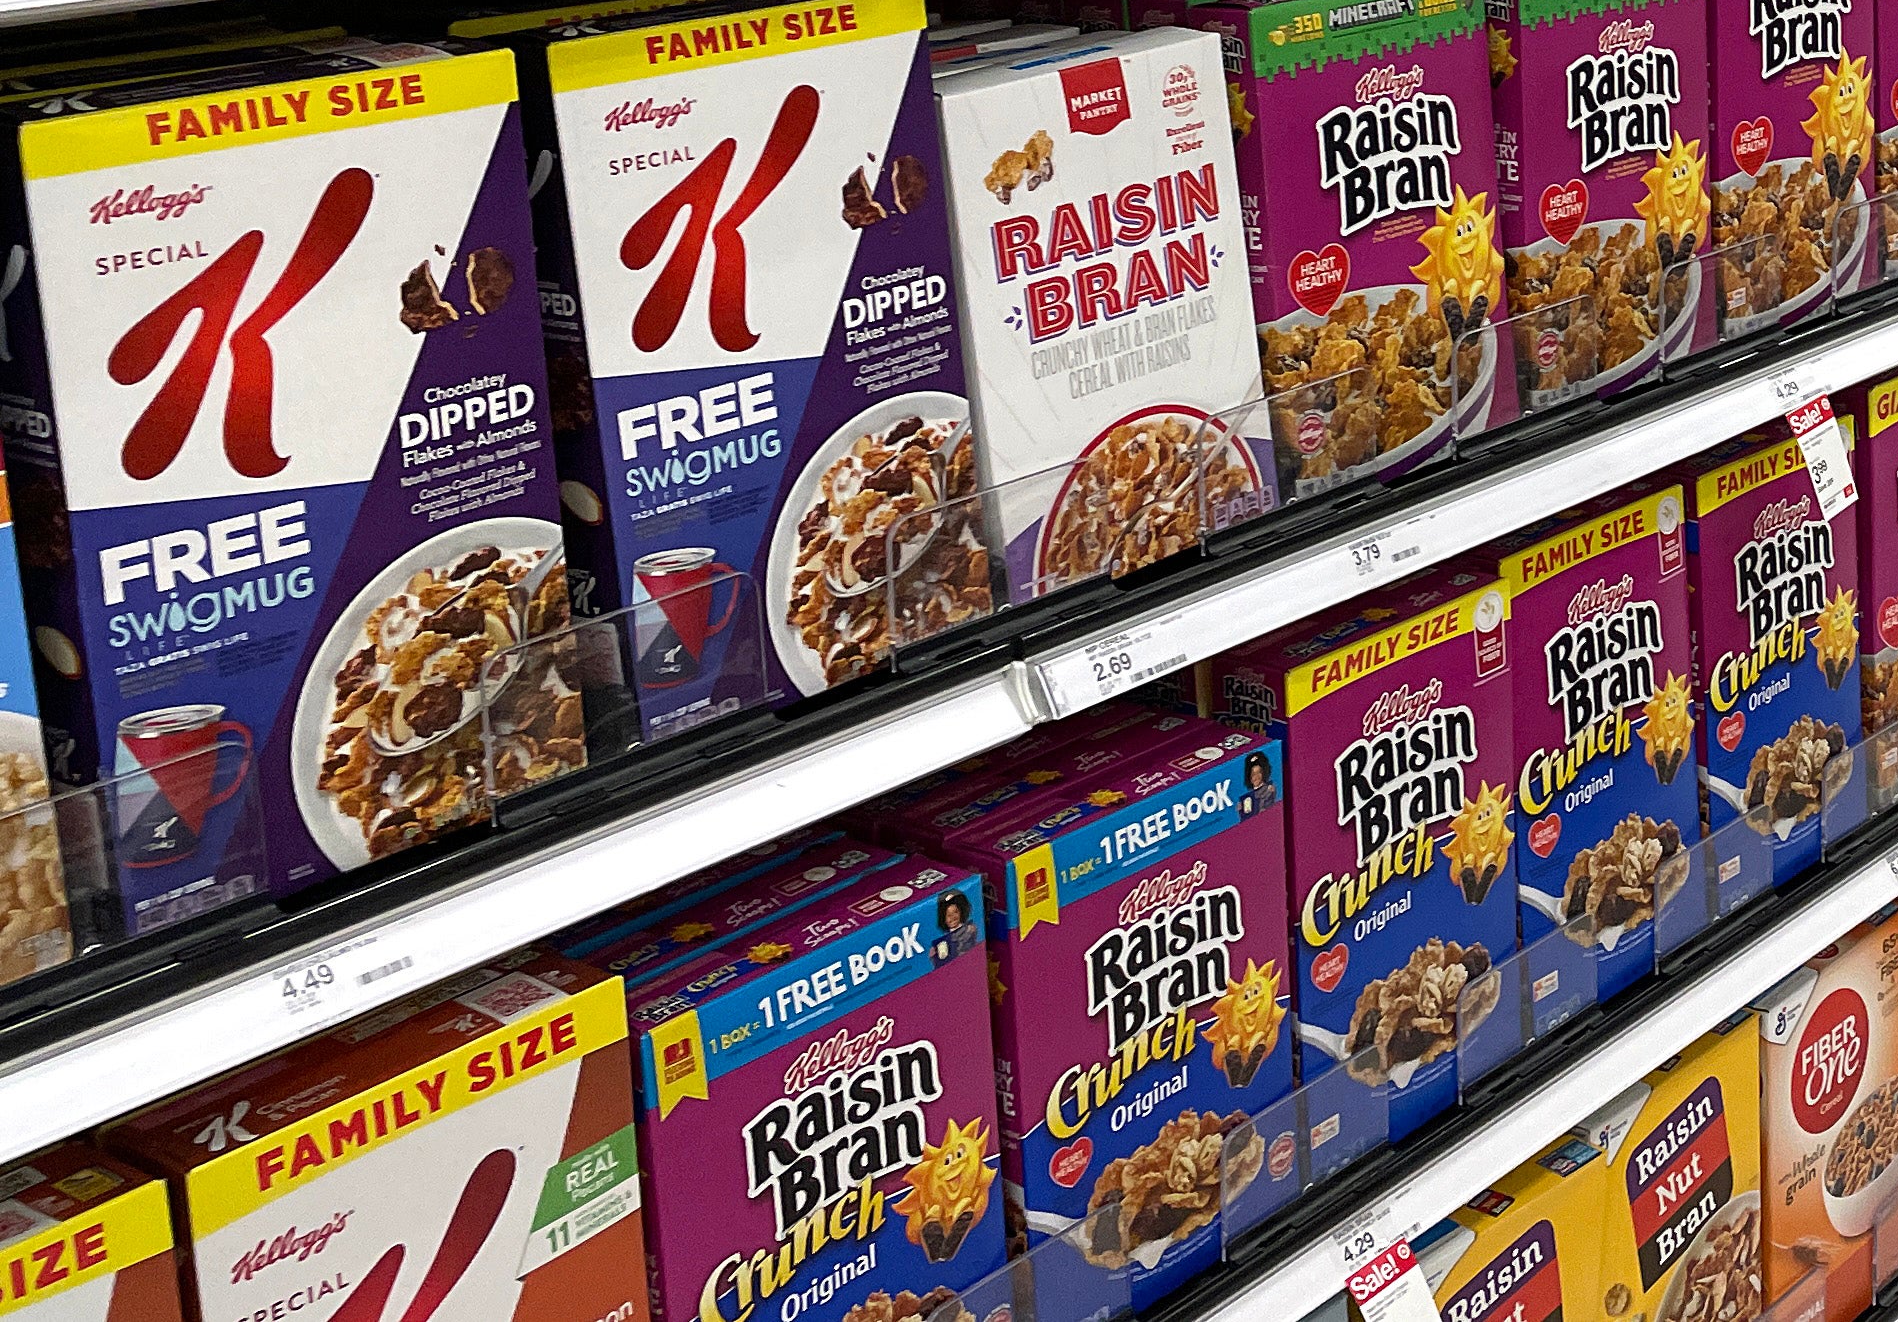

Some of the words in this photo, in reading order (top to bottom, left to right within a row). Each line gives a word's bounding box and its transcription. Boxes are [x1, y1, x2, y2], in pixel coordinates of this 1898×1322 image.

[645, 19, 768, 64] FAMILY
[784, 4, 857, 40] SIZE
[1761, 7, 1843, 79] Bran
[146, 92, 308, 146] FAMILY
[328, 75, 425, 117] SIZE
[1071, 87, 1122, 114] MARKET
[1355, 65, 1424, 104] Kellogg's
[1172, 139, 1204, 156] Fiber
[1318, 95, 1460, 189] Raisin
[89, 184, 206, 224] Kellogg's
[993, 163, 1220, 283] RAISIN
[1341, 147, 1454, 237] Bran
[96, 241, 209, 275] SPECIAL
[1023, 234, 1211, 344] BRAN
[1296, 265, 1344, 292] HEALTHY
[1300, 256, 1336, 277] HEART
[842, 275, 947, 328] DIPPED
[1098, 327, 1134, 360] WHEAT
[1147, 313, 1176, 342] BRAN
[1179, 296, 1216, 333] FLAKES
[424, 373, 507, 404] Chocolatey
[1069, 366, 1112, 400] CEREAL
[1115, 356, 1146, 383] WITH
[1148, 334, 1191, 373] RAISINS
[1776, 380, 1799, 400] 4.29
[399, 385, 535, 447] DIPPED
[403, 443, 454, 469] Flakes
[476, 419, 537, 448] Almonds
[1790, 402, 1823, 434] Sale!
[100, 501, 311, 607] FREE
[1352, 545, 1381, 568] 3.79
[1093, 653, 1132, 681] 2.69
[1310, 631, 1401, 693] FAMILY
[1405, 606, 1461, 651] SIZE
[1336, 707, 1476, 825] Raisin
[1359, 761, 1465, 867] Bran
[1301, 820, 1435, 947] Crunch
[1354, 891, 1412, 941] Original
[281, 964, 335, 1000] 4.49
[759, 995, 775, 1027] 1
[776, 971, 848, 1023] FREE
[849, 923, 925, 987] BOOK
[784, 1016, 893, 1093] Kellogg's
[1801, 1015, 1856, 1076] FIBER
[256, 1073, 448, 1193] FAMILY
[468, 1013, 578, 1094] SIZE
[744, 1040, 941, 1199] Raisin
[1634, 1093, 1717, 1185] Raisin
[565, 1151, 619, 1193] REAL
[770, 1104, 926, 1240] Bran
[1655, 1154, 1704, 1214] Nut
[699, 1176, 887, 1322] Crunch
[1343, 1232, 1376, 1263] 4.29
[1655, 1191, 1719, 1268] Bran
[780, 1244, 877, 1322] Original
[1350, 1255, 1401, 1302] Sale!
